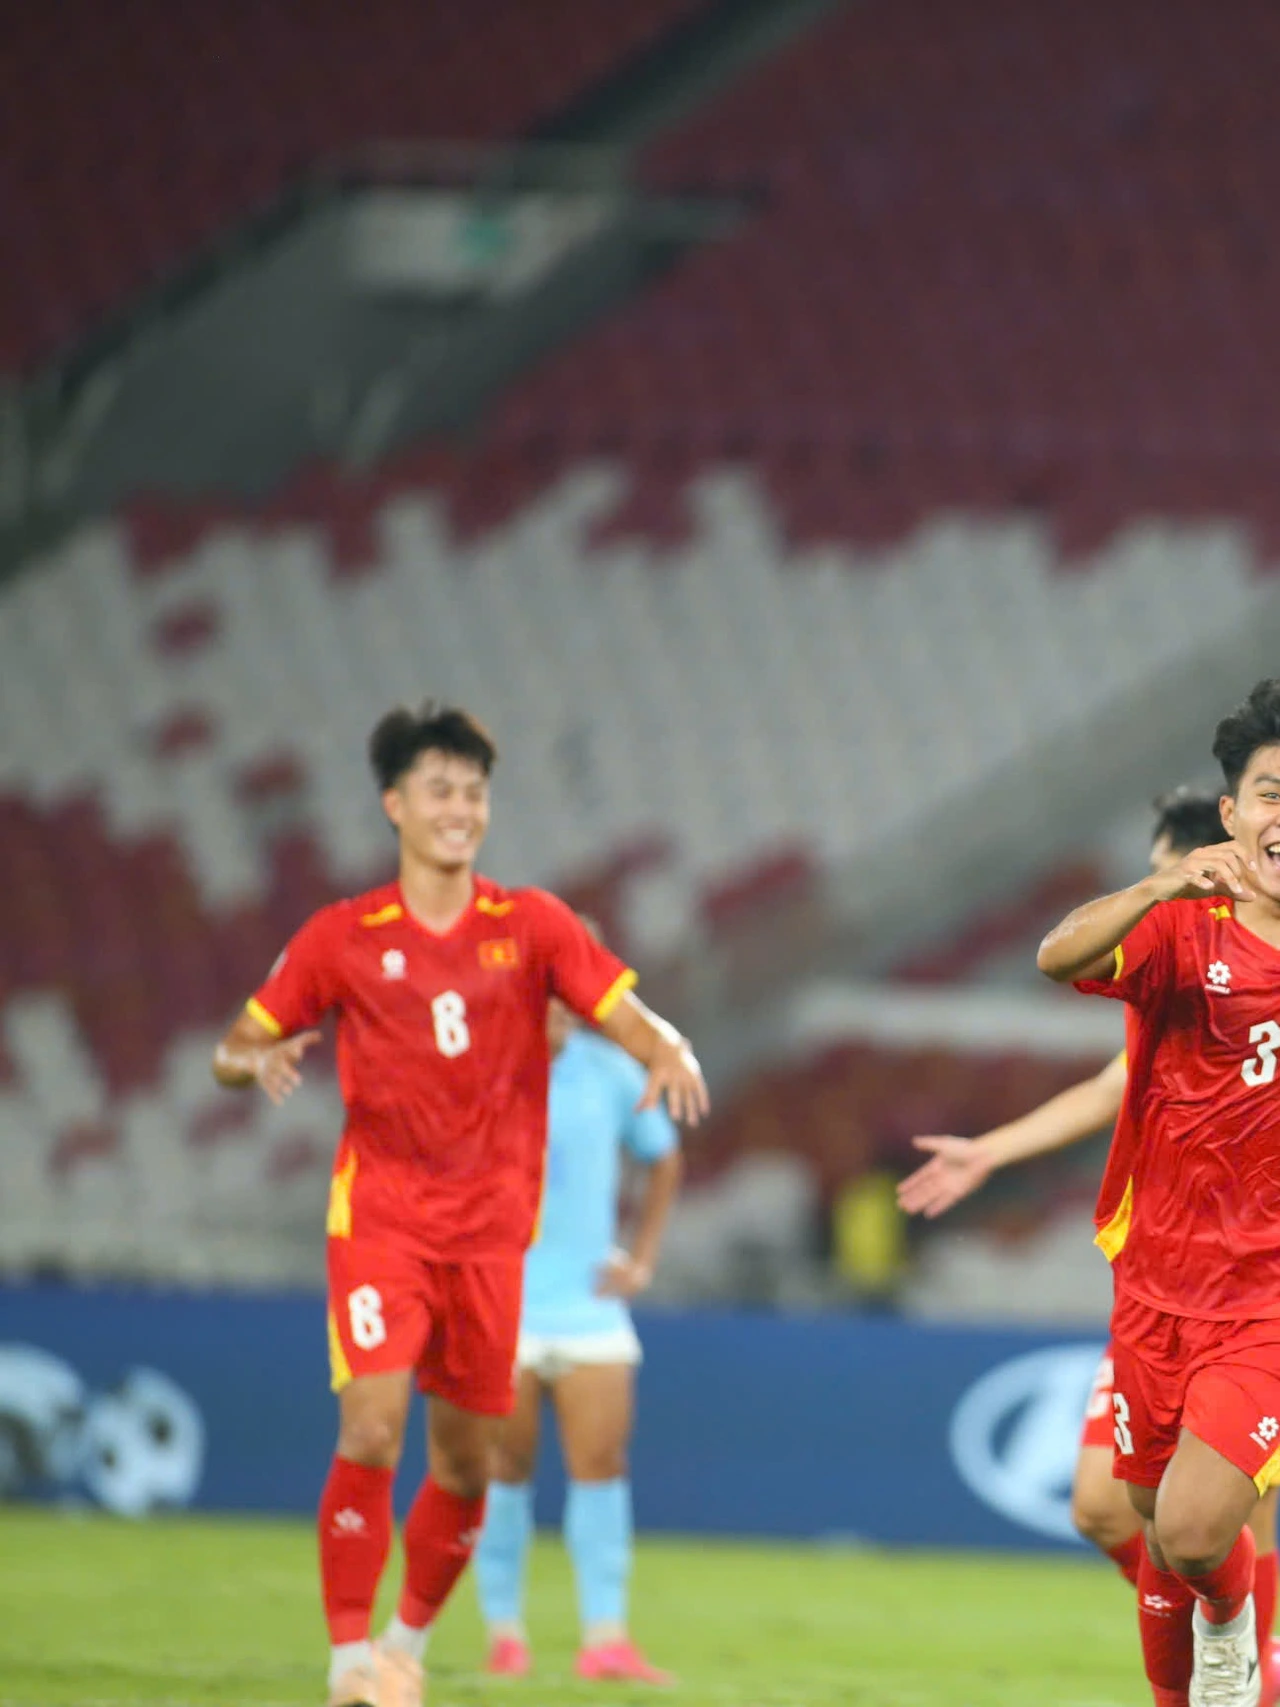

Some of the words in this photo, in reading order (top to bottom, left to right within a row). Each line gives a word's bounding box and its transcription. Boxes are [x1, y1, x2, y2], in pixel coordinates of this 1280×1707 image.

[432, 990, 470, 1058] 8
[348, 1284, 387, 1350] 8
[1112, 1392, 1134, 1455] 3
